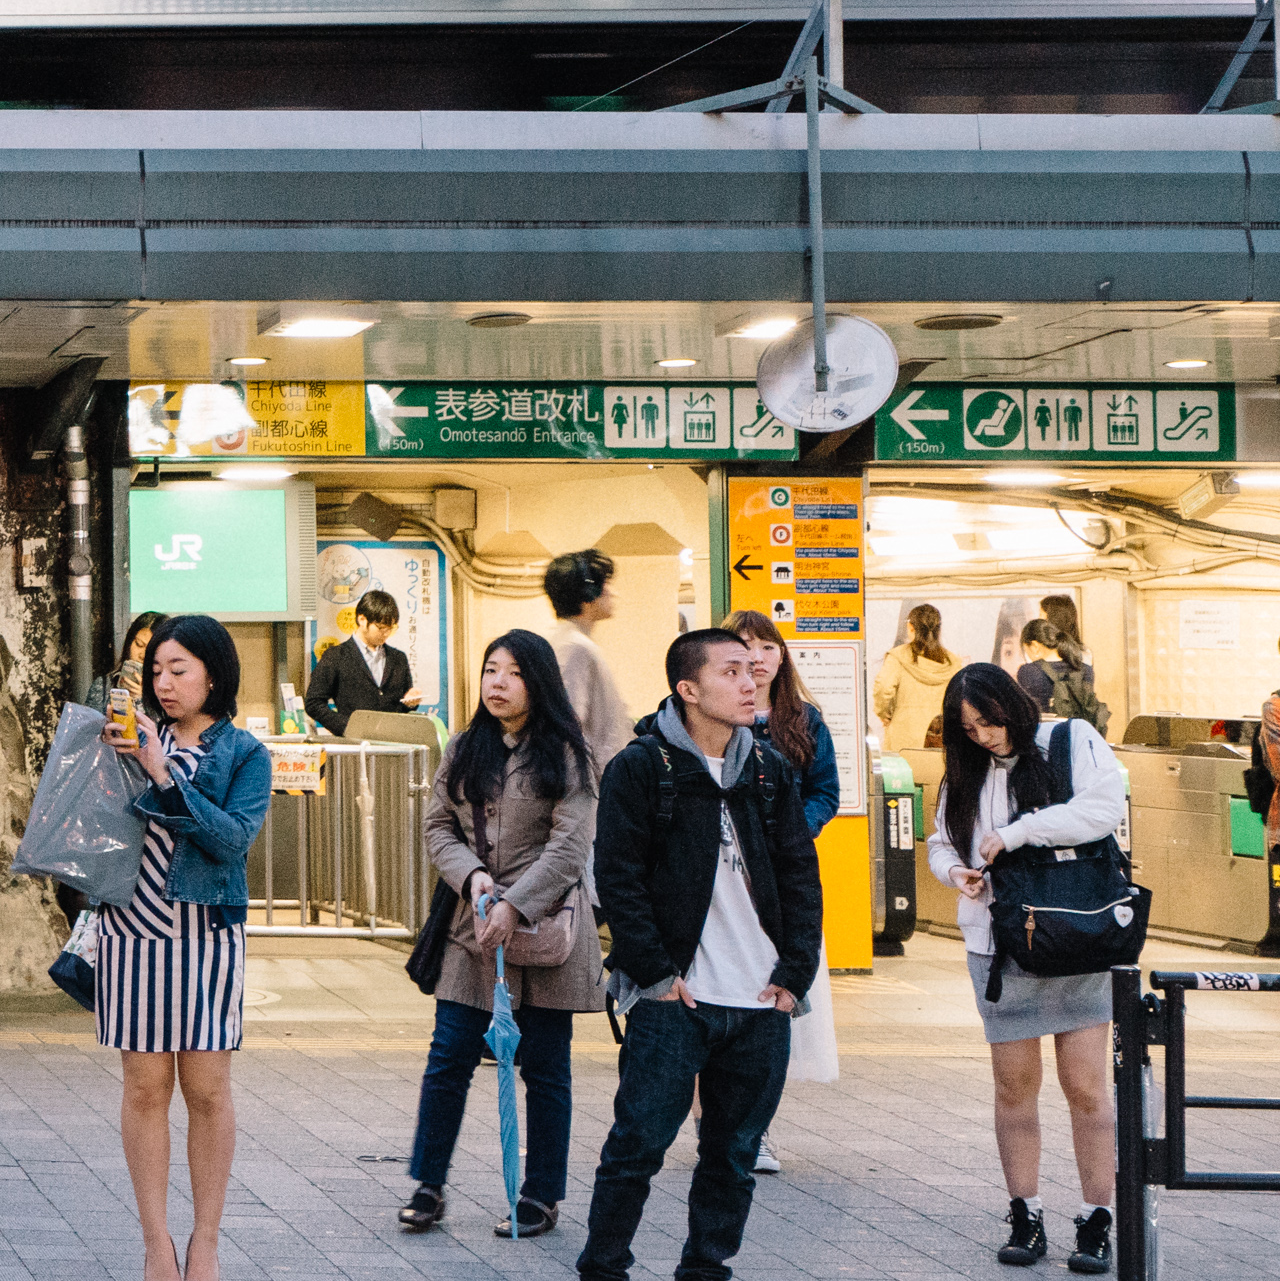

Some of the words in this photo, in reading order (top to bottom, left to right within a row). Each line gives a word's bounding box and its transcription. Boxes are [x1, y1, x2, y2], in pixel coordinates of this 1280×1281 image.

[250, 380, 328, 400] 千代田線
[251, 400, 302, 414] Chiyoda
[306, 401, 333, 412] Line
[434, 387, 600, 423] 表参道改札
[251, 419, 329, 438] 副都心線
[439, 426, 527, 444] Omotesandō
[533, 427, 596, 444] Entrance
[252, 441, 322, 453] Fukutoshin
[326, 441, 353, 453] Line
[899, 441, 946, 455] (150m)
[154, 534, 203, 562] JR
[404, 558, 420, 615] ゆっくり
[421, 558, 432, 615] 自動改札機は
[277, 761, 307, 773] 危険
